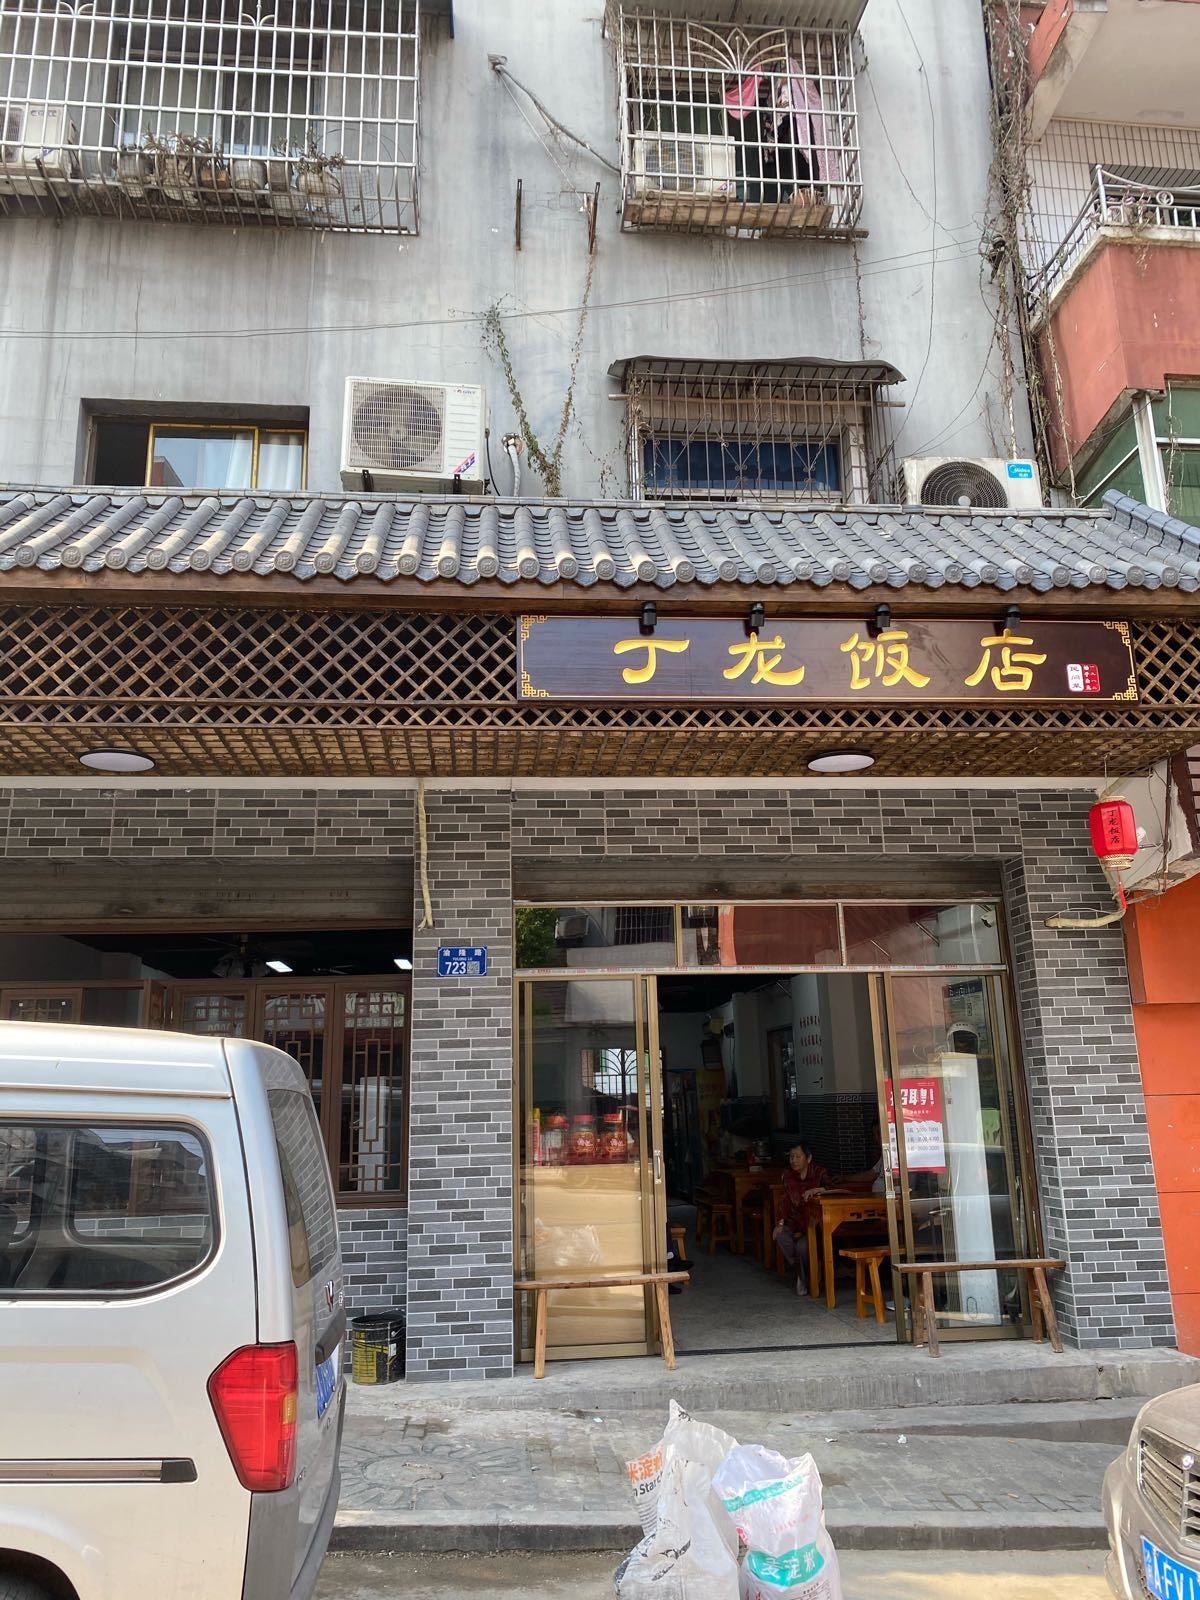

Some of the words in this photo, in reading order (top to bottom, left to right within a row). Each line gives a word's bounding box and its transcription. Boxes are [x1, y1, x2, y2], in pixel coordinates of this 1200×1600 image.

[613, 627, 1048, 691] 丁龙饭店
[444, 961, 467, 975] 723
[751, 1549, 816, 1580] 麦淀粉
